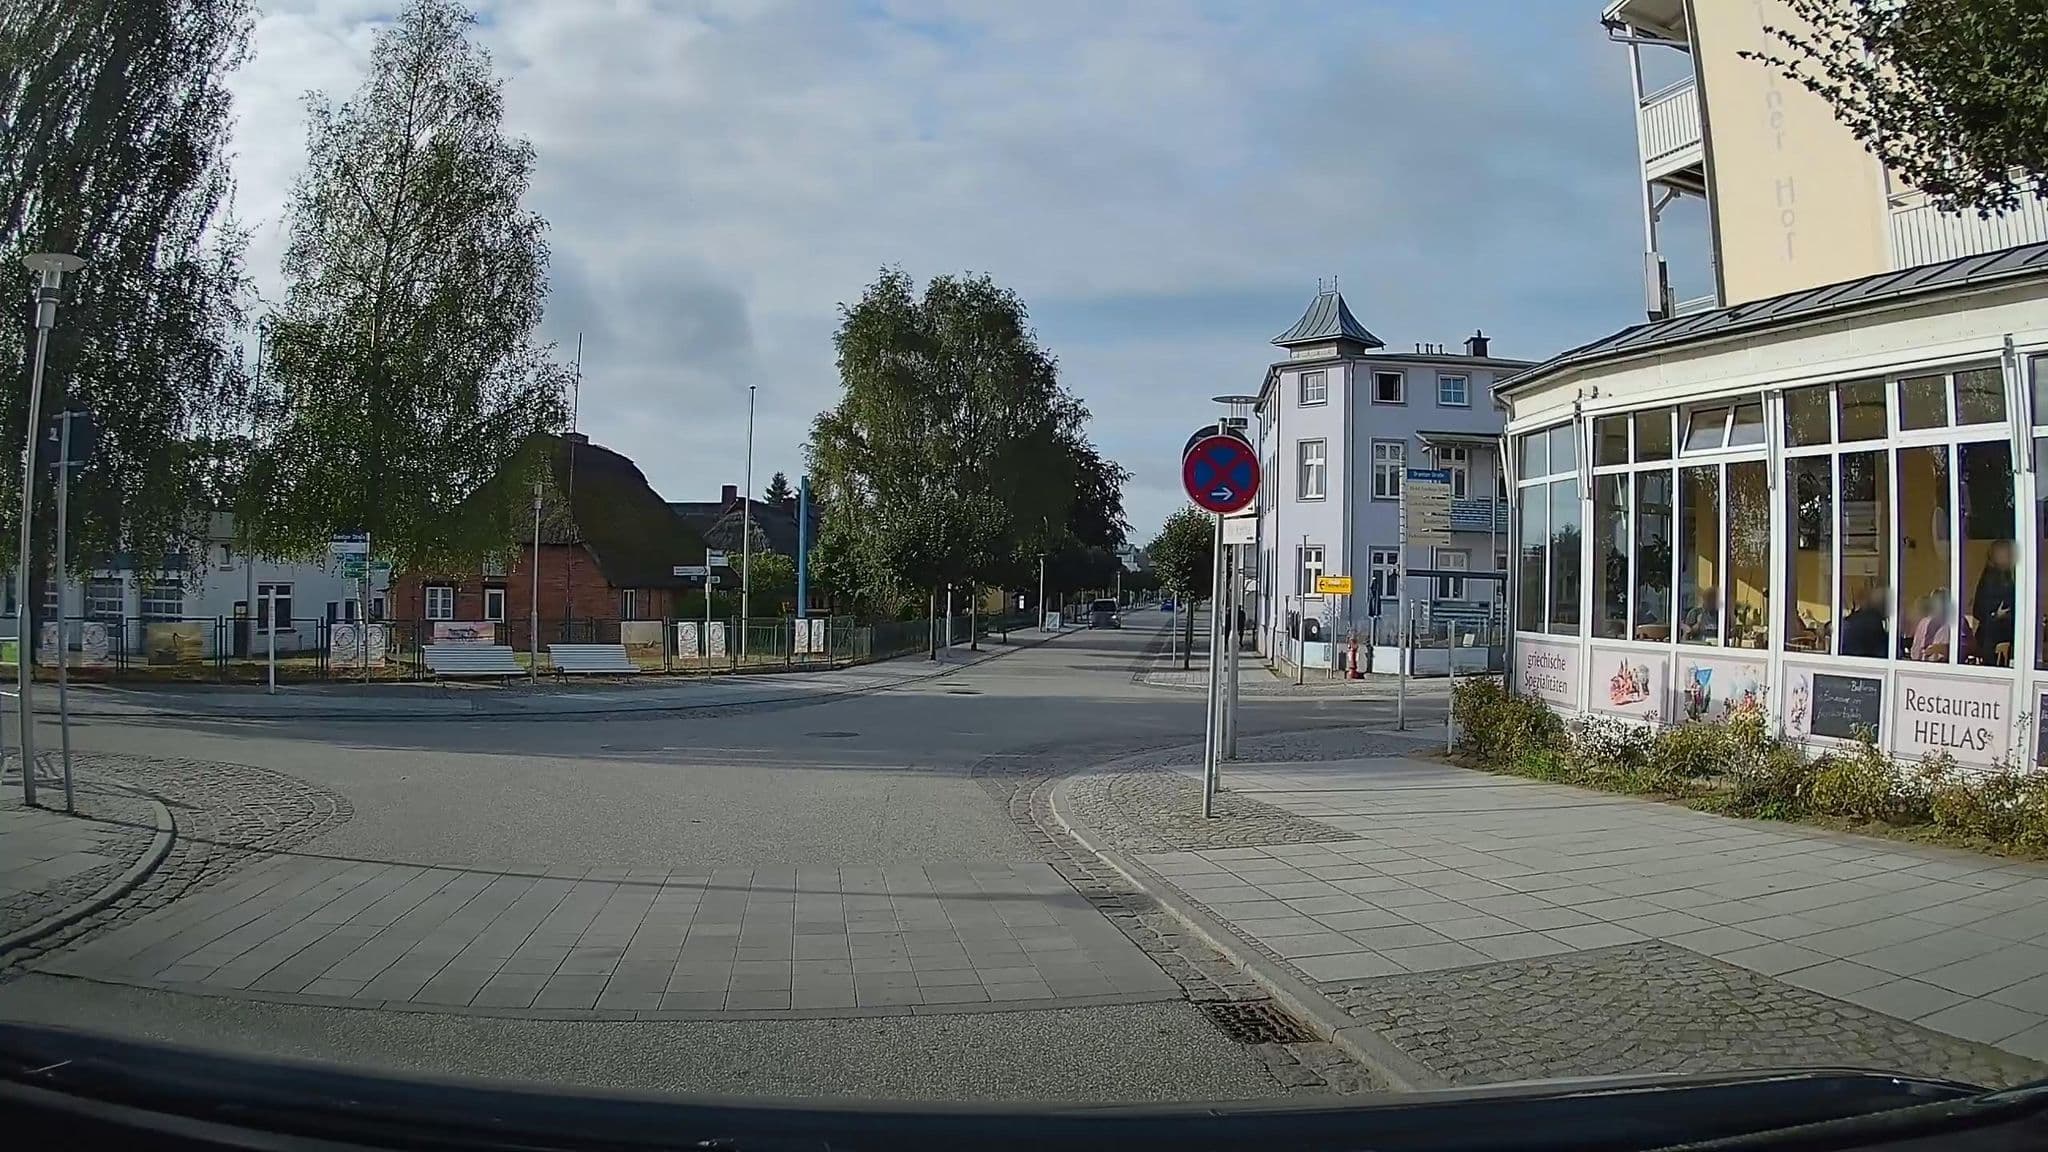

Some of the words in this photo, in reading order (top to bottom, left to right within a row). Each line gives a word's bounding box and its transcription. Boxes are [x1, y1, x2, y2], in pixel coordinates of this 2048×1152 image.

[1775, 175, 1796, 263] Hof
[1527, 650, 1566, 671] griechische
[1524, 670, 1568, 694] Spezialitäten
[1905, 687, 2001, 721] Restaurant
[1914, 719, 1987, 751] HELLAS
